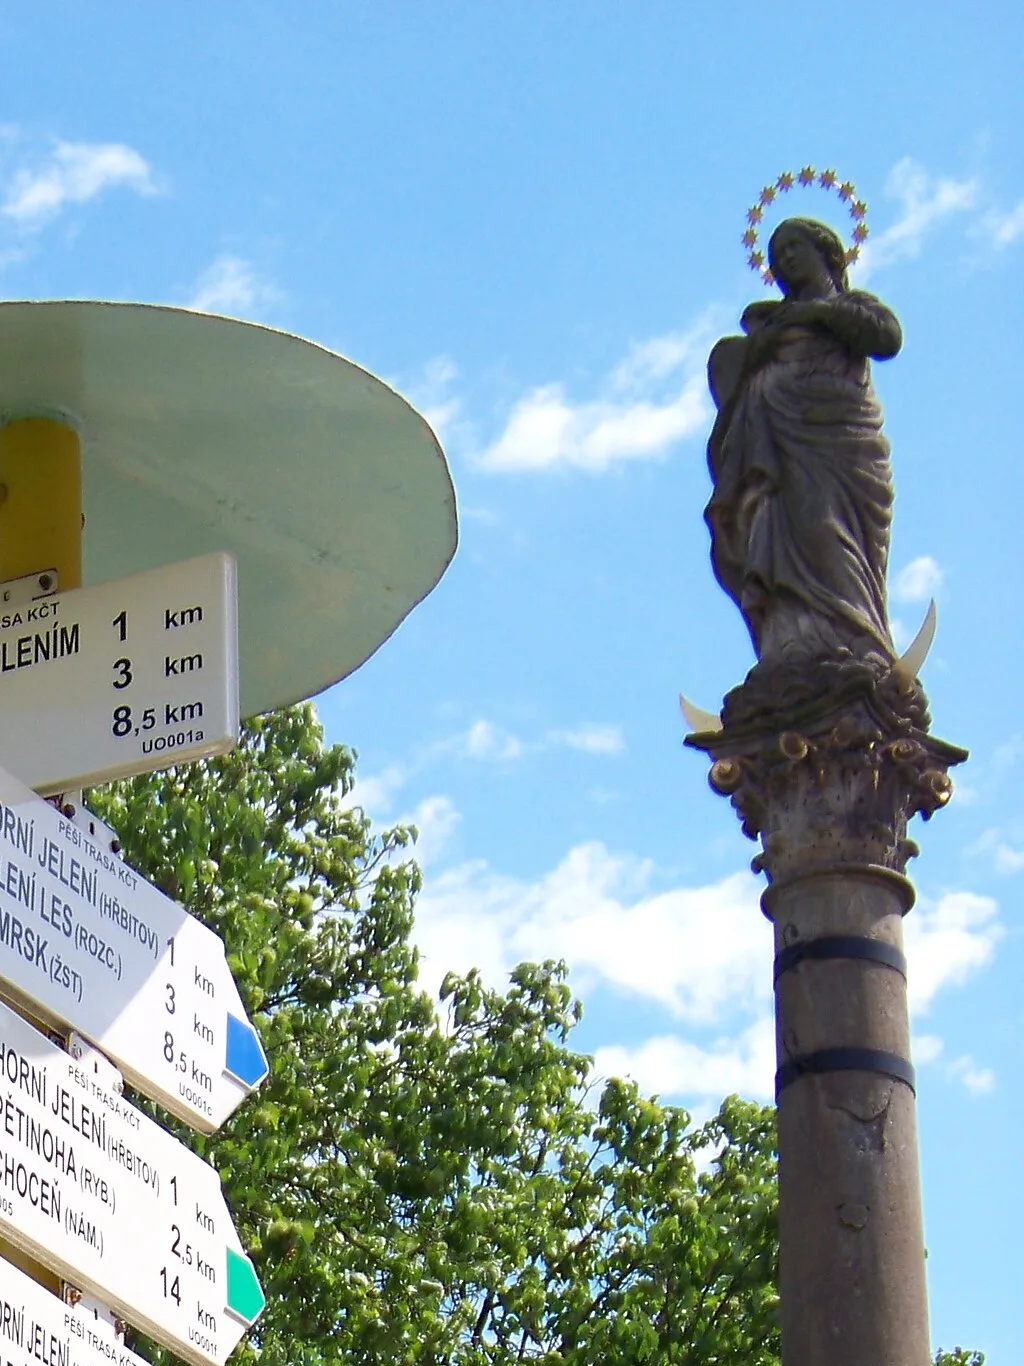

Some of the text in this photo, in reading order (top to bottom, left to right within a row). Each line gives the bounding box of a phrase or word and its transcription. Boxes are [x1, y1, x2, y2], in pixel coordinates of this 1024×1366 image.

[26, 602, 60, 628] KČT
[112, 612, 127, 641] 1
[165, 604, 203, 630] km
[112, 658, 132, 689] 3
[165, 651, 203, 677] km
[112, 705, 156, 737] 8,5
[165, 701, 204, 726] km
[142, 729, 204, 754] UO001a
[58, 821, 138, 891] PĚŠÍ TRASA KČT
[39, 838, 98, 908] JELENÍ
[100, 891, 159, 959] (HŘBITOV)
[167, 937, 175, 966] 1
[194, 965, 215, 998] km
[41, 888, 72, 938] LES
[75, 923, 122, 980] (ROZC.)
[165, 983, 175, 1014] 3
[194, 1013, 214, 1046] km
[50, 954, 83, 1003] (ŽST)
[164, 1031, 187, 1073] 8,5
[192, 1060, 212, 1092] km
[68, 1065, 141, 1131] PĚŠÍ TRASA KČT
[179, 1082, 212, 1116] UO001c
[52, 1084, 107, 1153] JELENÍ
[108, 1134, 160, 1198] (HŘBITOV)
[170, 1176, 178, 1207] 1
[196, 1203, 215, 1235] km
[80, 1164, 117, 1216] (RYB.)
[171, 1225, 193, 1266] 2,5
[197, 1252, 216, 1284] km
[65, 1203, 104, 1259] (NÁM.)
[160, 1267, 182, 1307] 14
[197, 1300, 216, 1333] km
[64, 1312, 84, 1339] PĚŠÍ
[86, 1328, 117, 1364] TRASA
